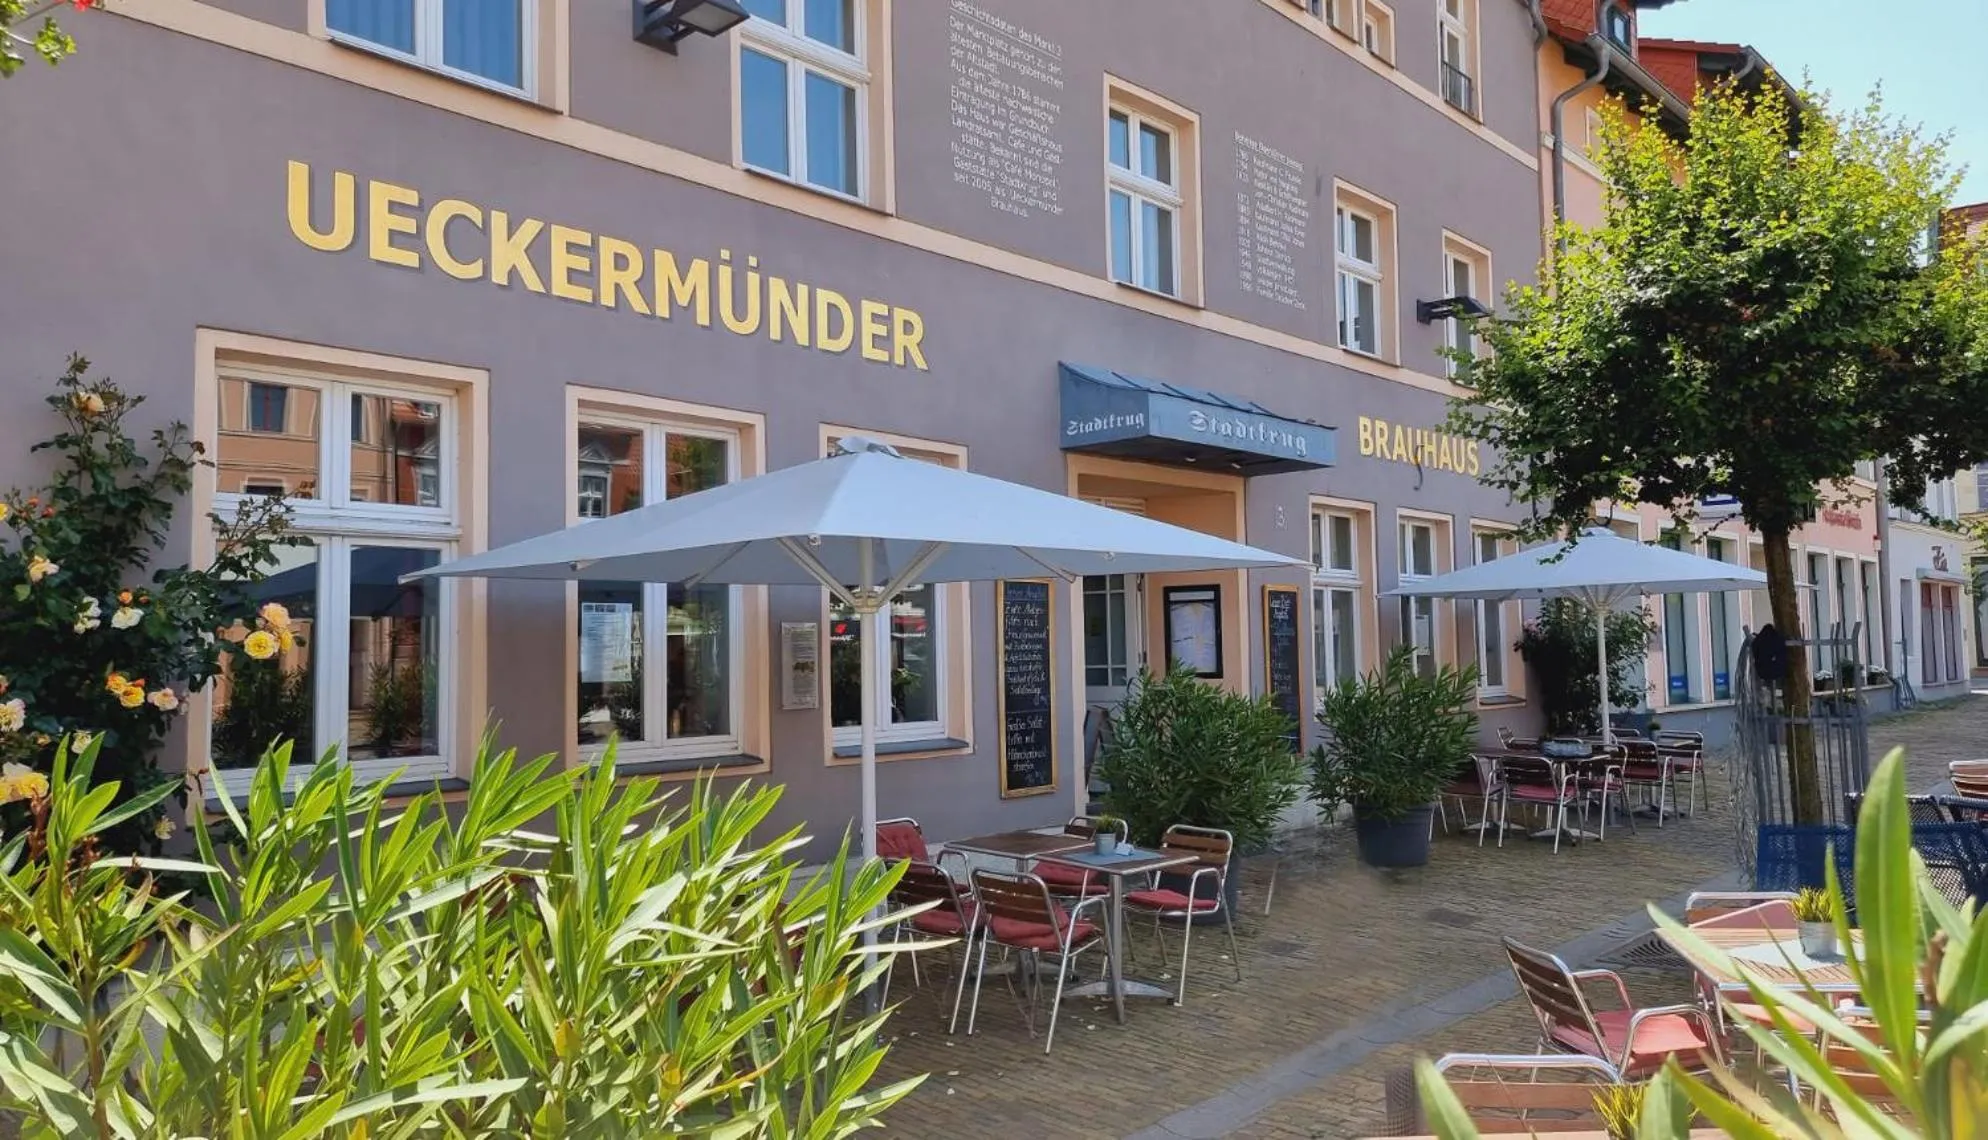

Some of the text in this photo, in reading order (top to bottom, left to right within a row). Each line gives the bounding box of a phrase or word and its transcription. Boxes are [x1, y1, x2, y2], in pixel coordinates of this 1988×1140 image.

[287, 160, 930, 371] UECKERMÜNDER
[1066, 411, 1145, 437] Stadtkrug
[1189, 409, 1307, 457] Stadtkrug
[1358, 415, 1480, 477] BRAUHAUS
